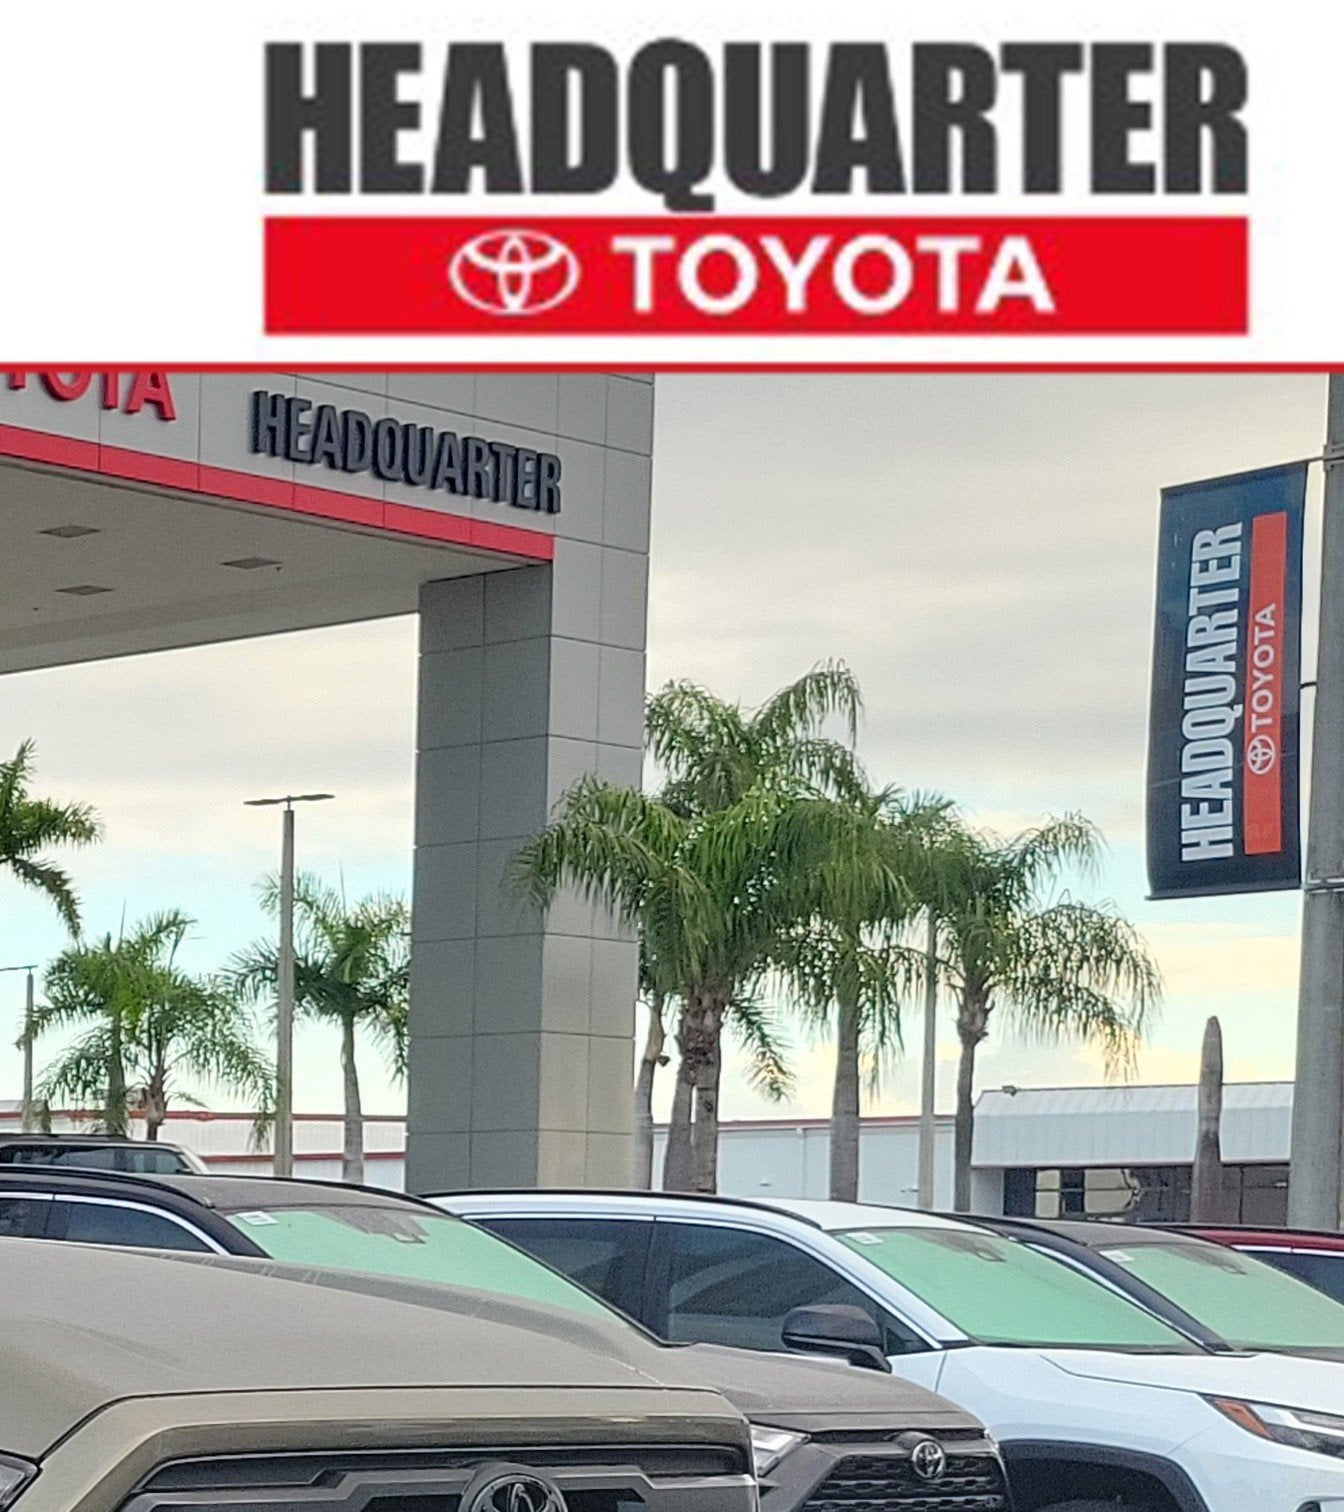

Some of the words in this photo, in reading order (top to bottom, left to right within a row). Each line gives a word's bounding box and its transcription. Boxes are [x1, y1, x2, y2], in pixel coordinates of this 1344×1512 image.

[251, 390, 562, 514] HEADQUARTER
[1180, 522, 1244, 862] HEADQUARTER
[1250, 602, 1276, 733] TOYOTA
